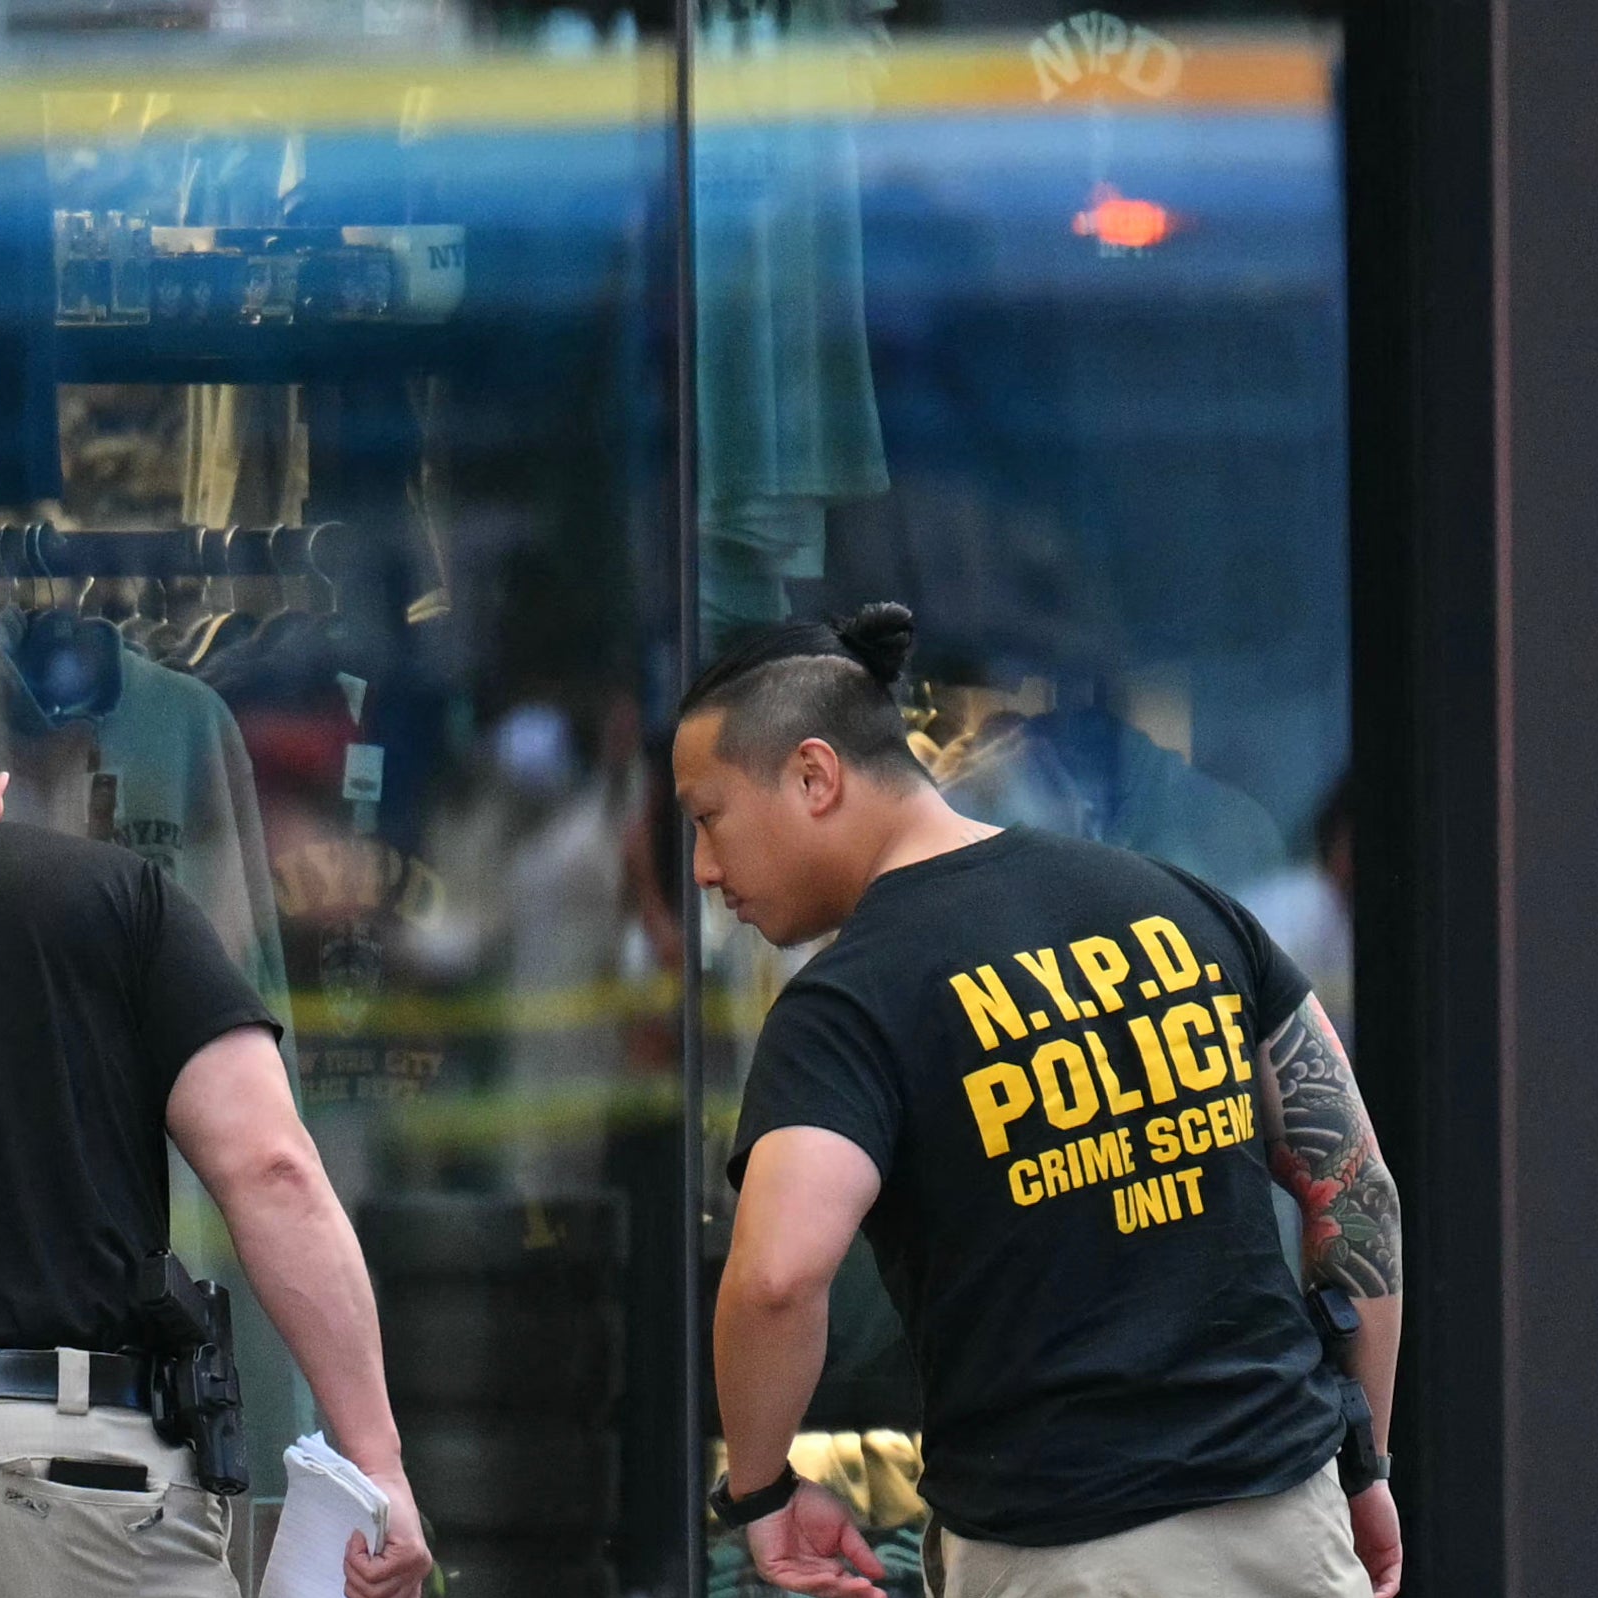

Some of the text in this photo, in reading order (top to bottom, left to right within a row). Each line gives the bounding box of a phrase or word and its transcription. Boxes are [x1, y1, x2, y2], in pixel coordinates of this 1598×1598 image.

[1031, 10, 1183, 101] NYPD
[949, 914, 1221, 1052] N.Y.P.D.
[962, 993, 1252, 1160] POLICE
[1008, 1093, 1255, 1207] CRIME SCENE
[1113, 1167, 1204, 1235] UNIT
